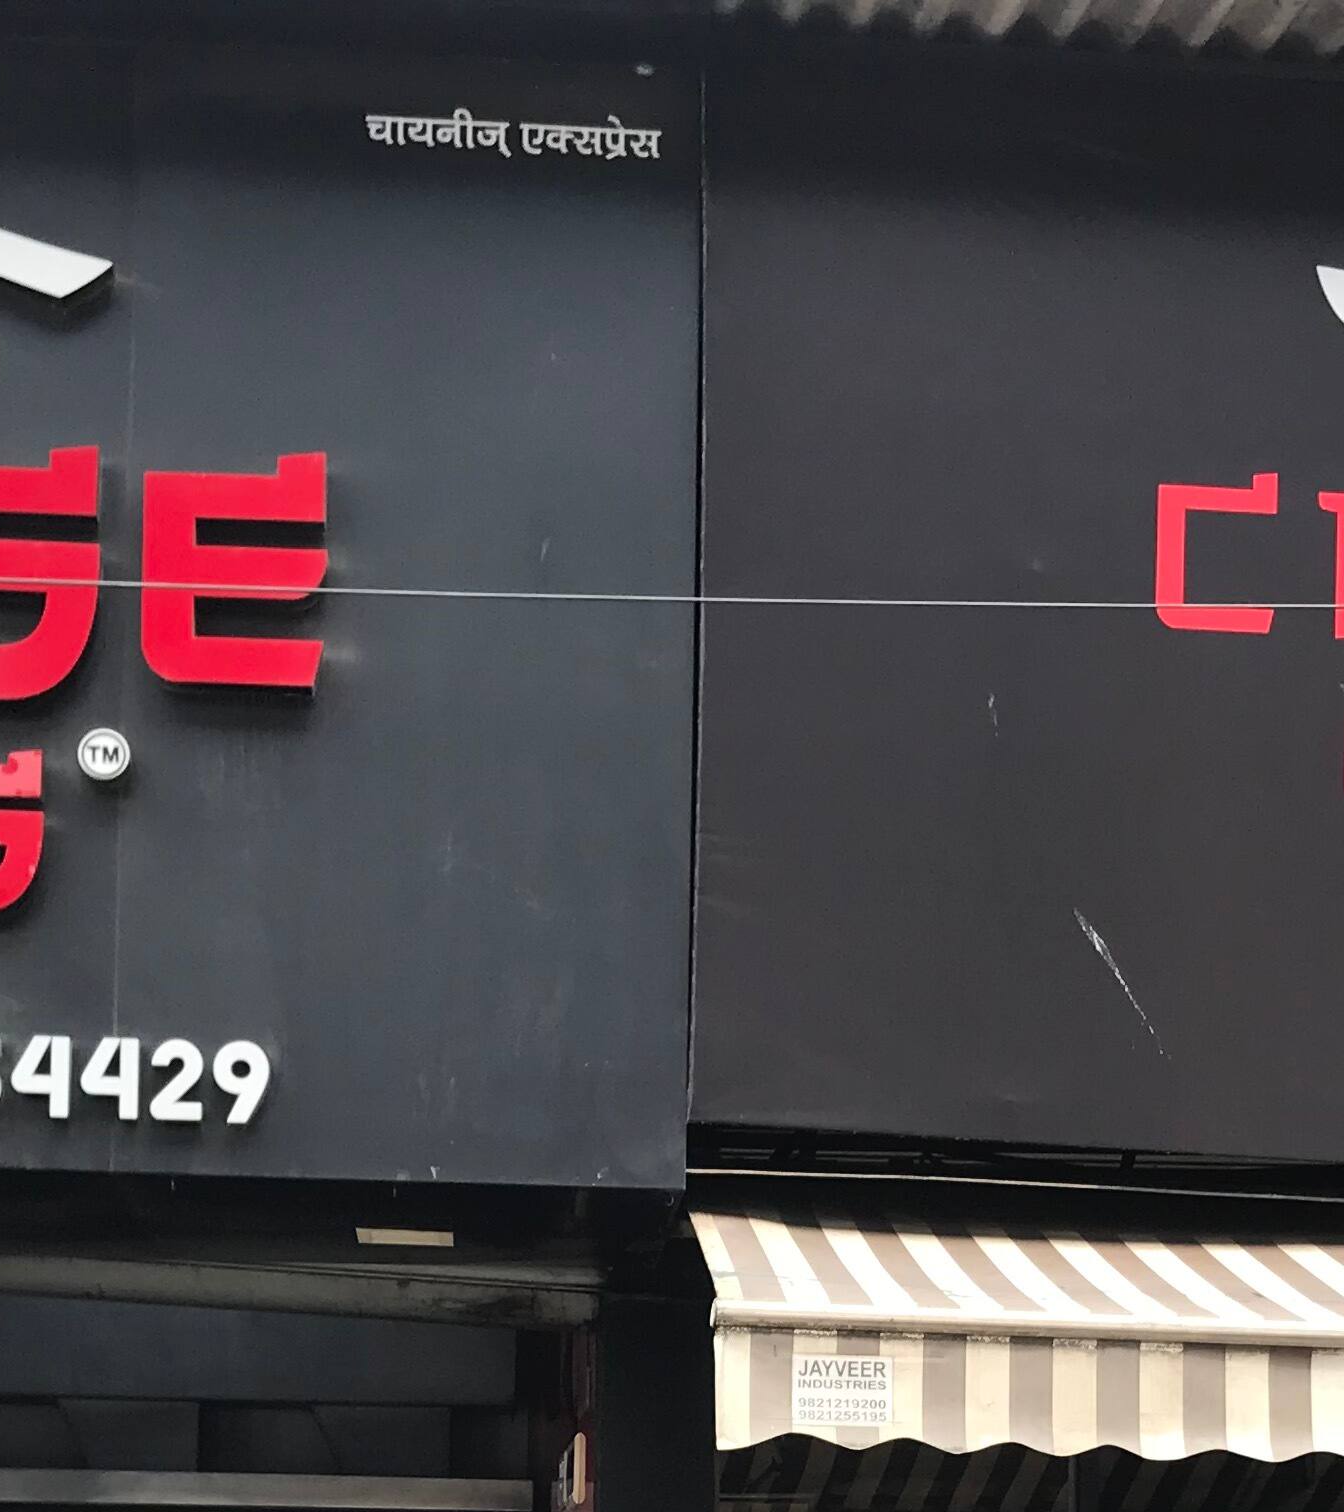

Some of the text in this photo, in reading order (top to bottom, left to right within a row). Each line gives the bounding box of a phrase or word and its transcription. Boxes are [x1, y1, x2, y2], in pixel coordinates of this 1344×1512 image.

[519, 114, 662, 160] एक्सप्रेस
[798, 1360, 886, 1378] JAYVEER
[797, 1379, 887, 1391] INDUSTRIES
[798, 1397, 887, 1409] 9821219200
